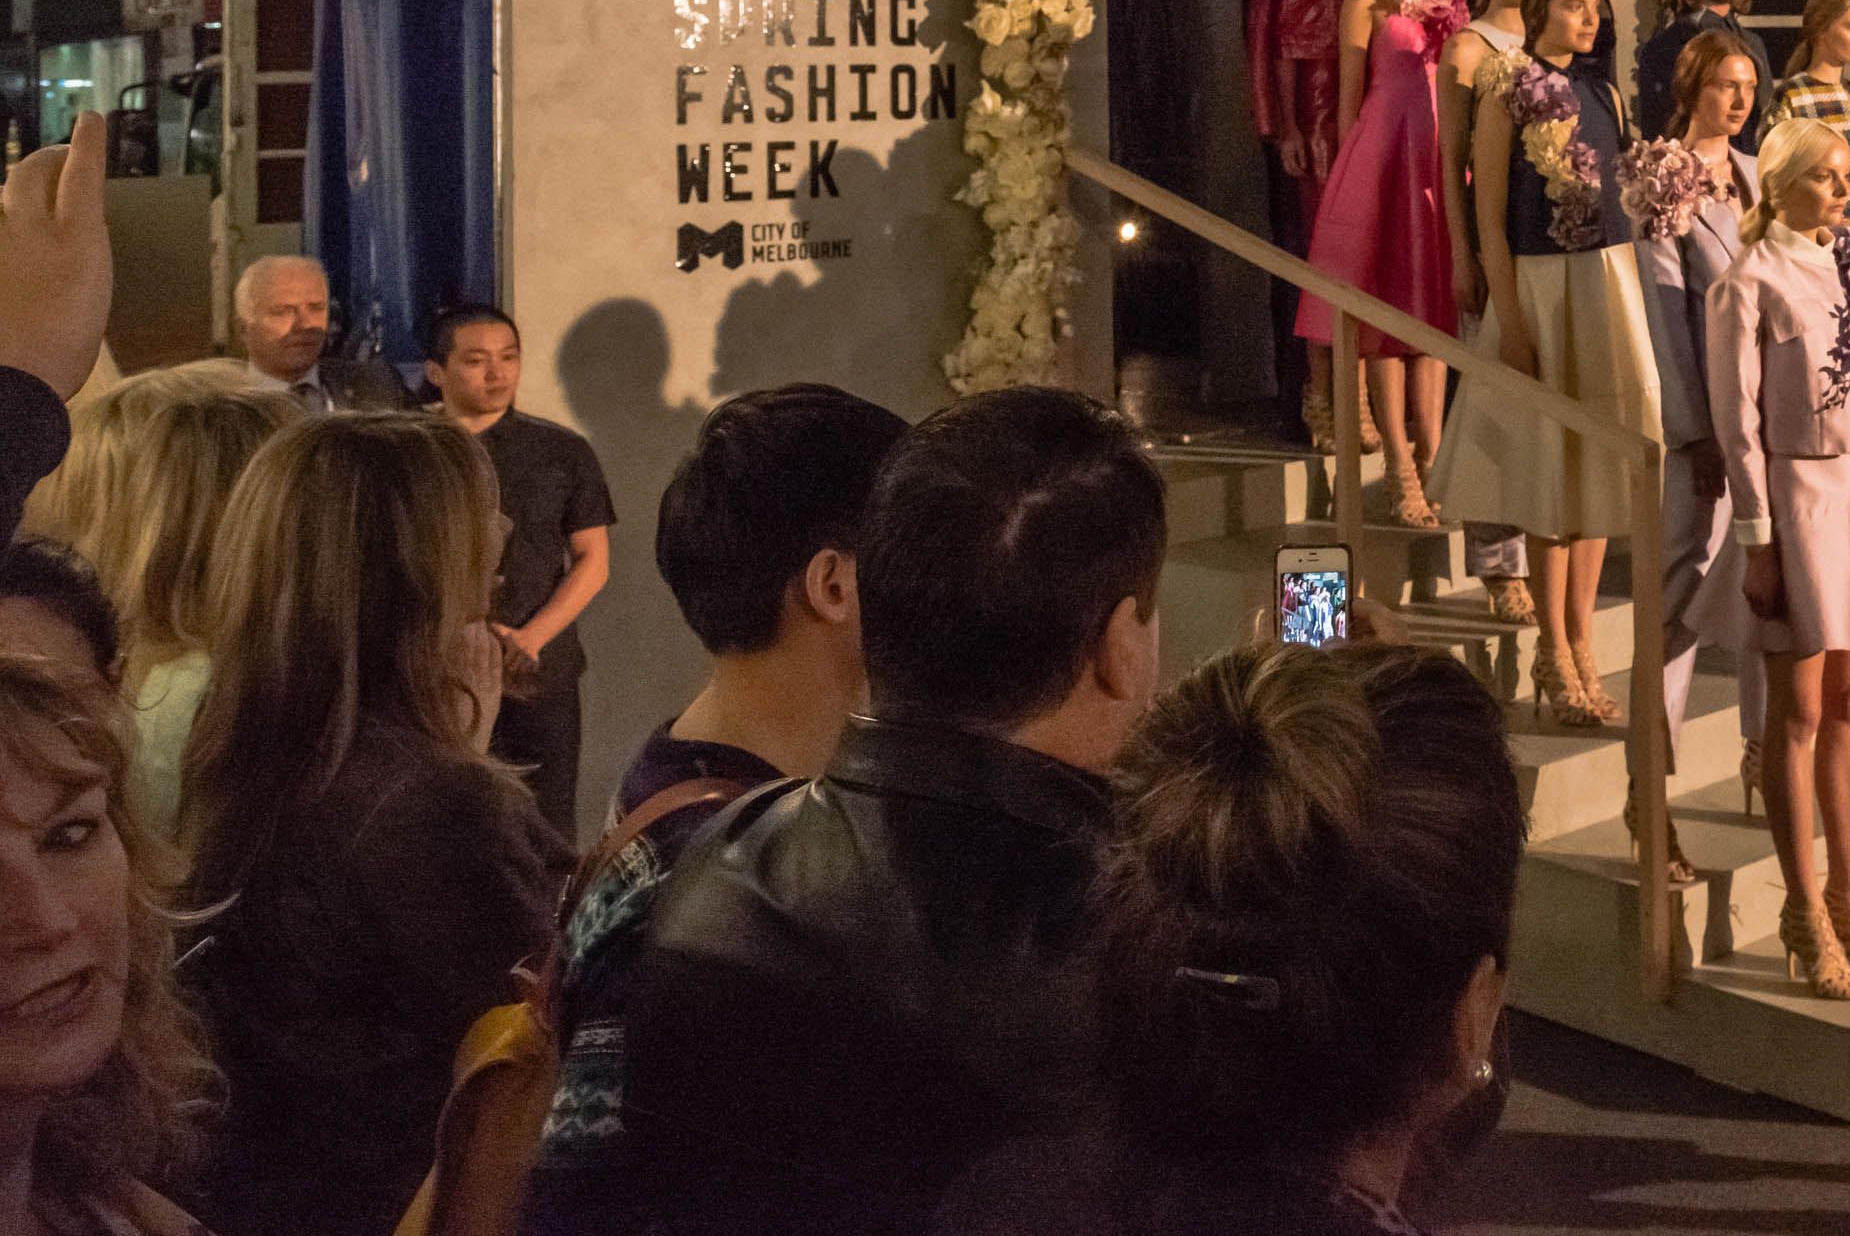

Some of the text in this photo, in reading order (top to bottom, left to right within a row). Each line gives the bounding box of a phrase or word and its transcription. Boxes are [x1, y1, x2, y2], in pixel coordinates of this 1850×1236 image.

[675, 63, 958, 126] FASHION
[675, 139, 840, 205] WEEK
[751, 221, 811, 243] CITY OF
[751, 239, 852, 264] MELBOURNE
